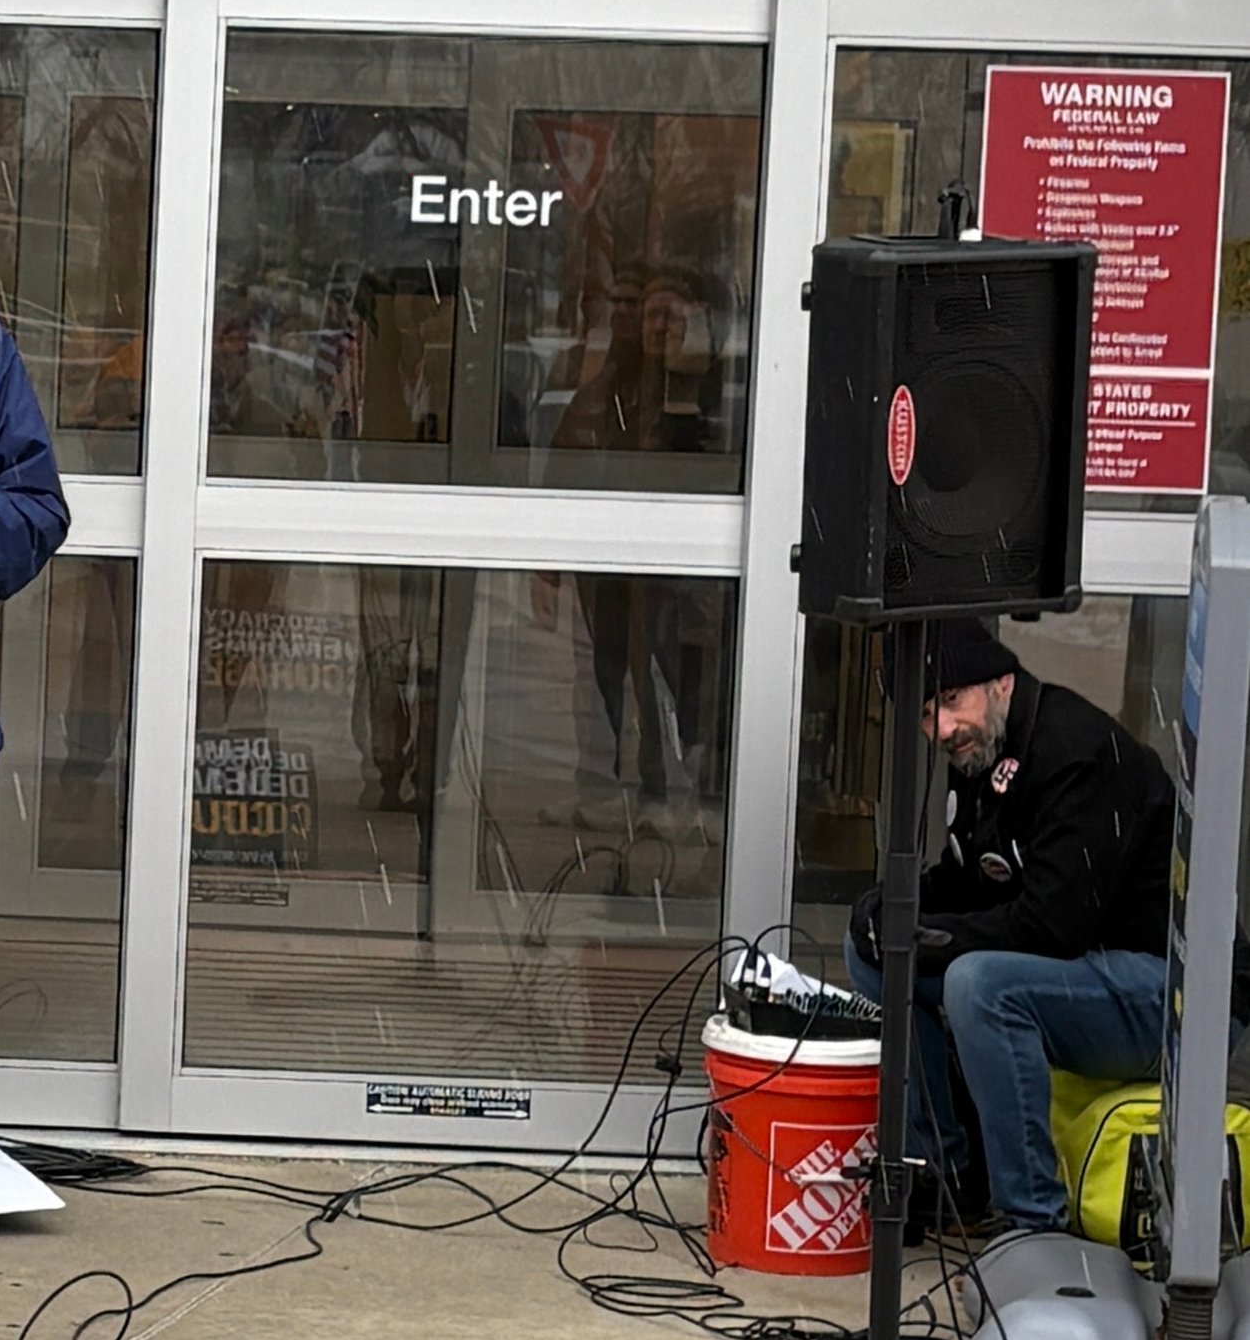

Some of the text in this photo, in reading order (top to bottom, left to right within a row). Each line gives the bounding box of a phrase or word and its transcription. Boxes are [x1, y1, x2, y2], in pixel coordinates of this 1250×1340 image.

[1040, 81, 1174, 109] WARNING
[1053, 108, 1161, 125] FEDERAL LAW
[1023, 135, 1075, 151] Prohibits
[1096, 138, 1151, 156] Following
[1154, 140, 1187, 154] Items
[1049, 153, 1158, 173] on Federal Property
[410, 174, 563, 227] Enter
[1092, 383, 1153, 400] STATES
[1105, 401, 1191, 418] PROPERTY
